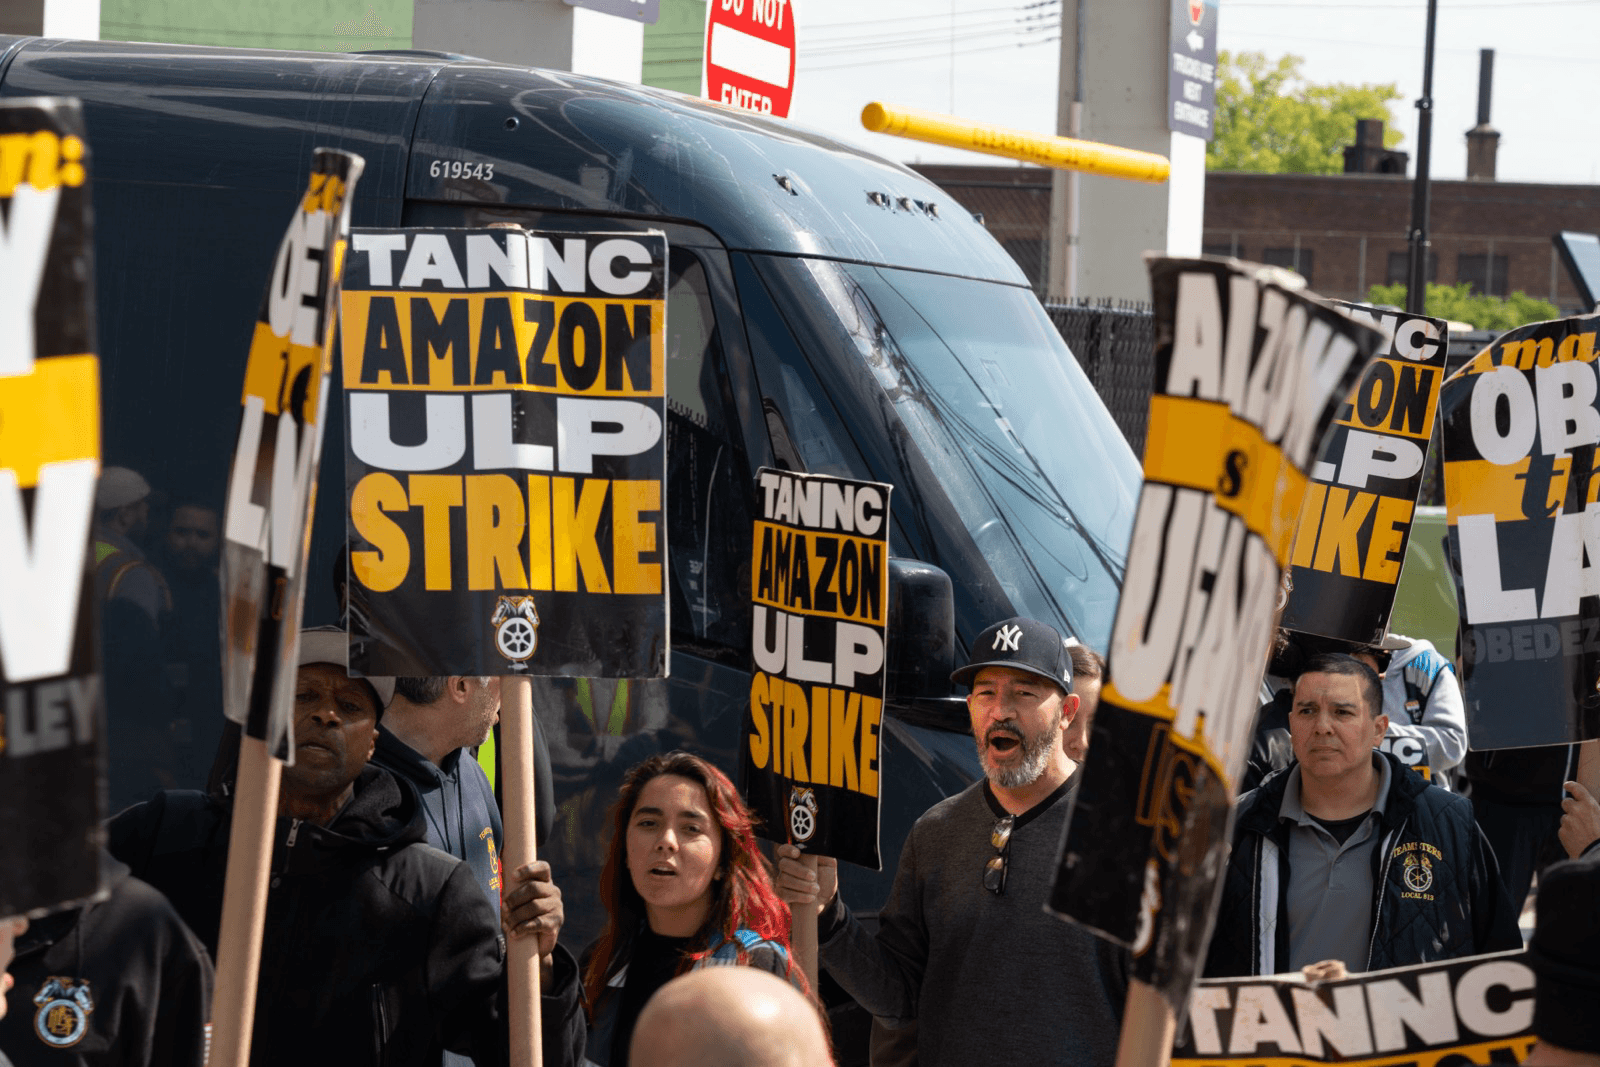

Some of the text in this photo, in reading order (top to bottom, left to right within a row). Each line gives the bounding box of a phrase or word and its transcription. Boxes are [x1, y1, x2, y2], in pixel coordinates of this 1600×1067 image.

[752, 0, 787, 31] NOT
[721, 83, 773, 115] ENTER
[429, 160, 495, 181] 619543
[352, 233, 653, 295] TANNC
[359, 295, 653, 392] AMAZON
[349, 392, 663, 474] ULP
[1470, 359, 1600, 466] OB
[350, 472, 663, 595] STRIKE
[759, 472, 883, 536] TANNC
[757, 525, 882, 622] AMAZON
[752, 604, 885, 689] ULP
[749, 670, 883, 799] STRIKE
[1401, 891, 1422, 899] LOCAL
[1189, 960, 1537, 1058] TANNC
